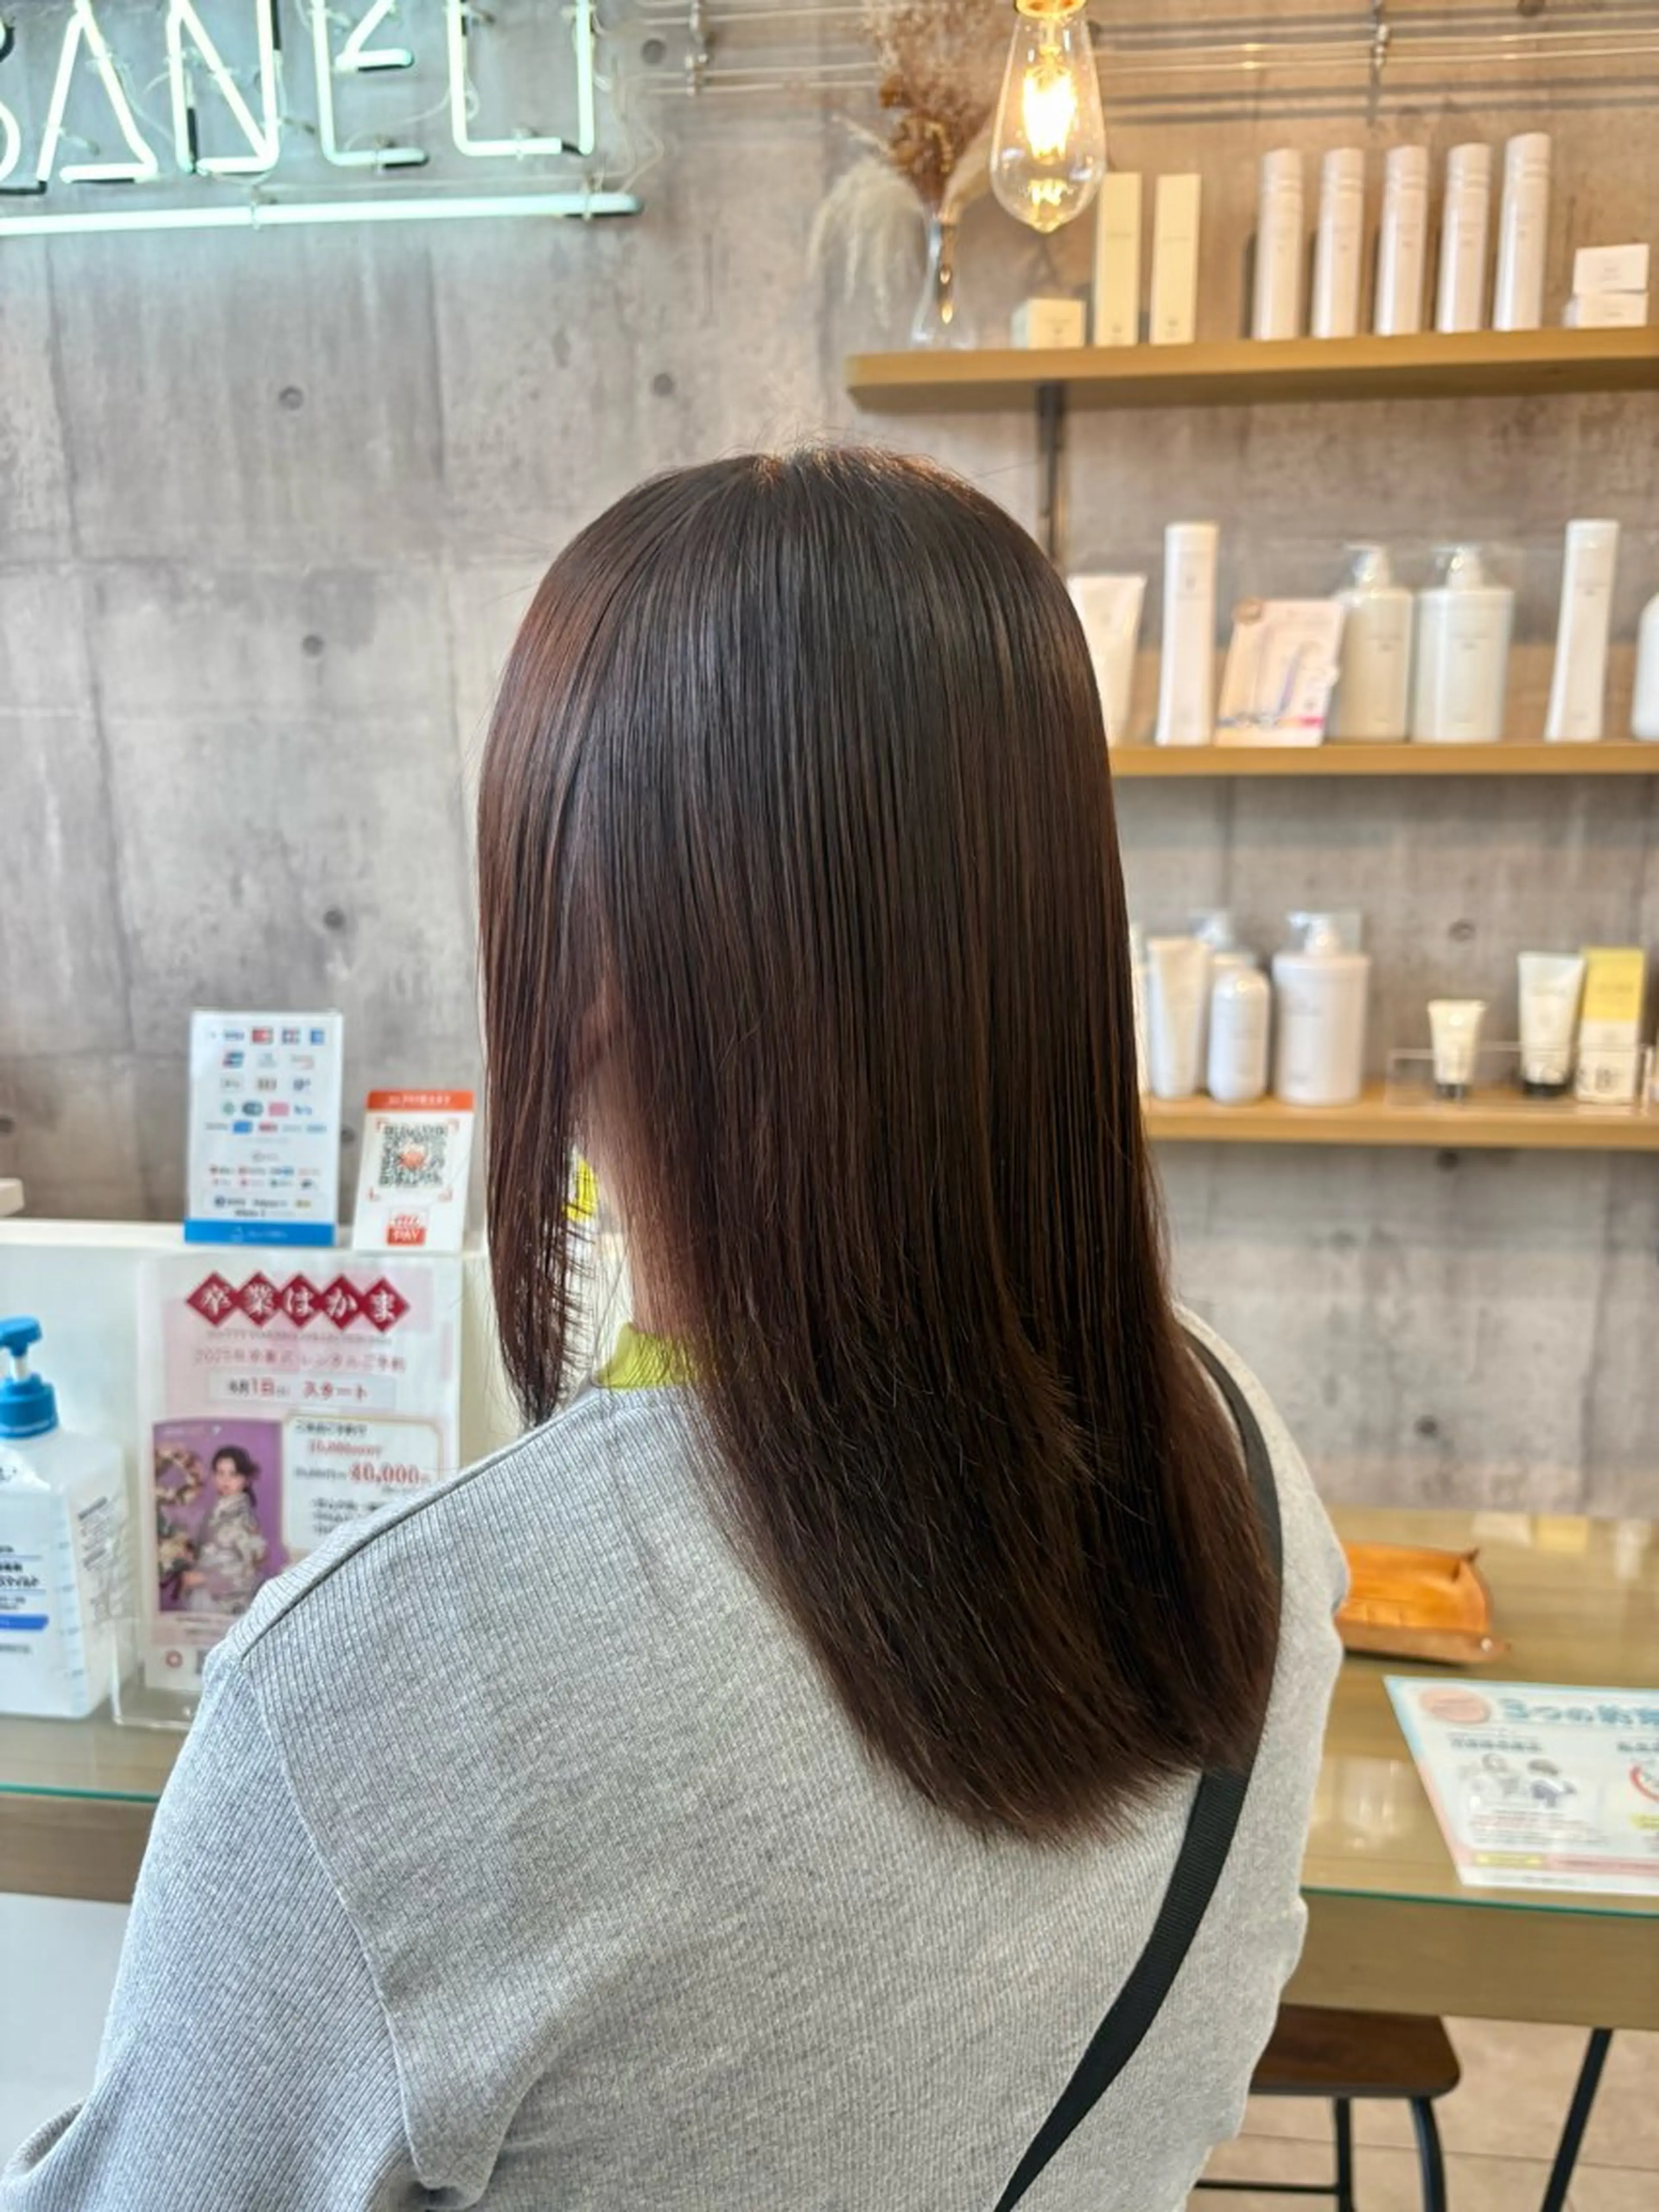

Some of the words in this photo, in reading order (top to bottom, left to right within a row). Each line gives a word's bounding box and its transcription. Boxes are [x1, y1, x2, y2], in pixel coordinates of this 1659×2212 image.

[202, 1285, 396, 1323] 卒業はかま
[302, 1379, 369, 1401] スタート
